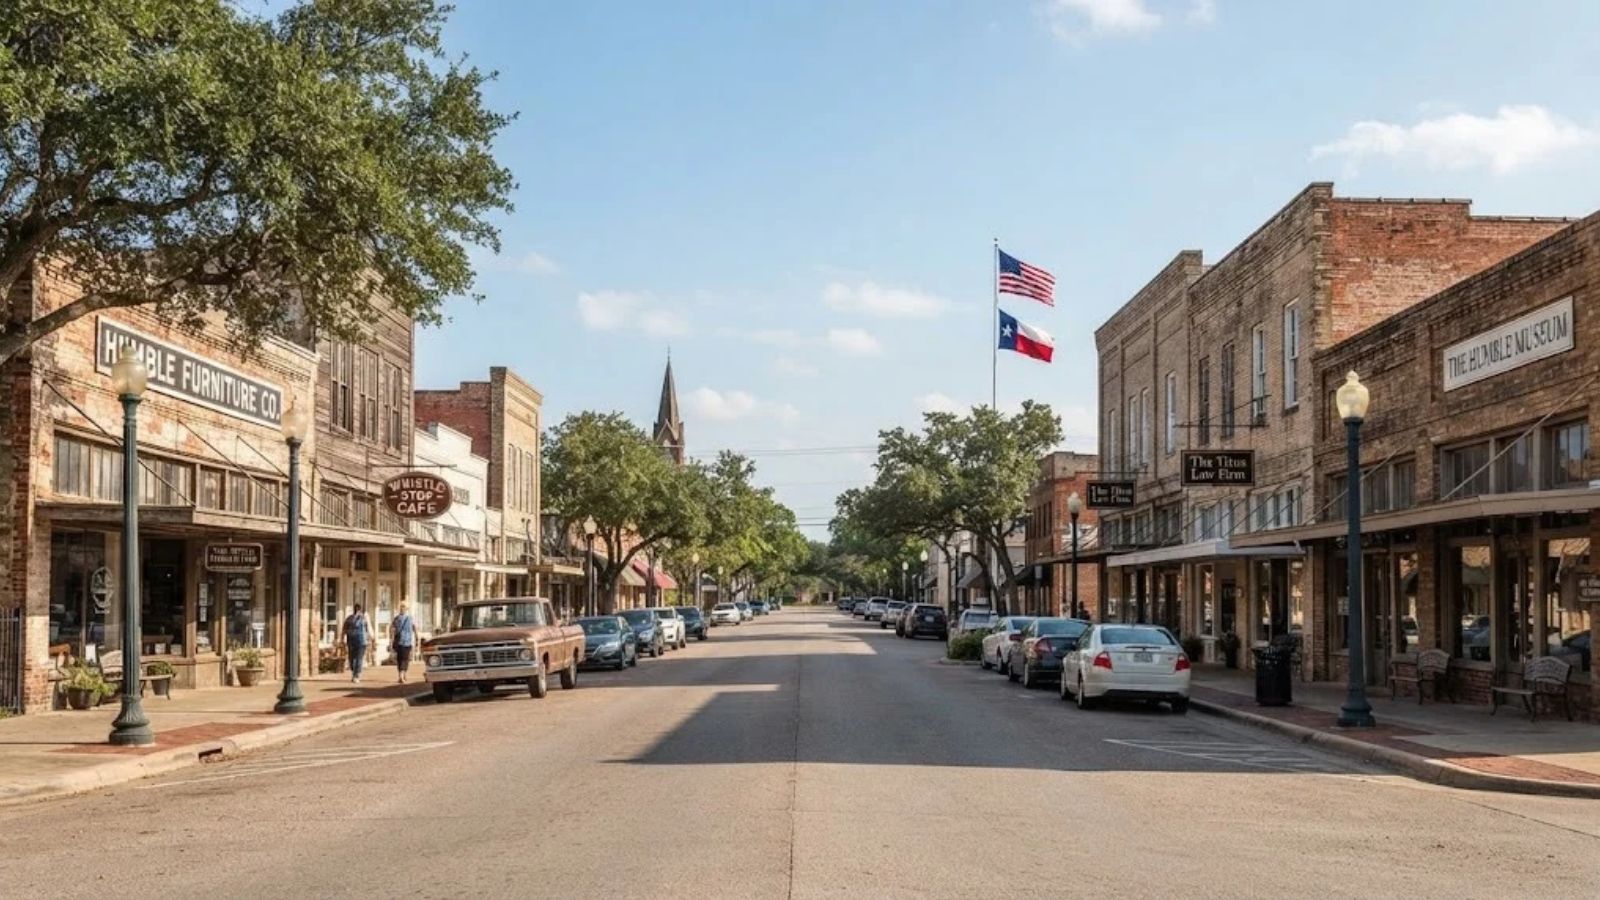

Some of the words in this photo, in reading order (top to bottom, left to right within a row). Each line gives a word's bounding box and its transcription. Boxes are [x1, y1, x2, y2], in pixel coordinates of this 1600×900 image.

[1515, 312, 1567, 356] MUSEUM
[182, 360, 256, 413] FURNITURE
[261, 391, 280, 420] CO.
[397, 501, 437, 514] CAFE
[401, 490, 433, 501] STOP
